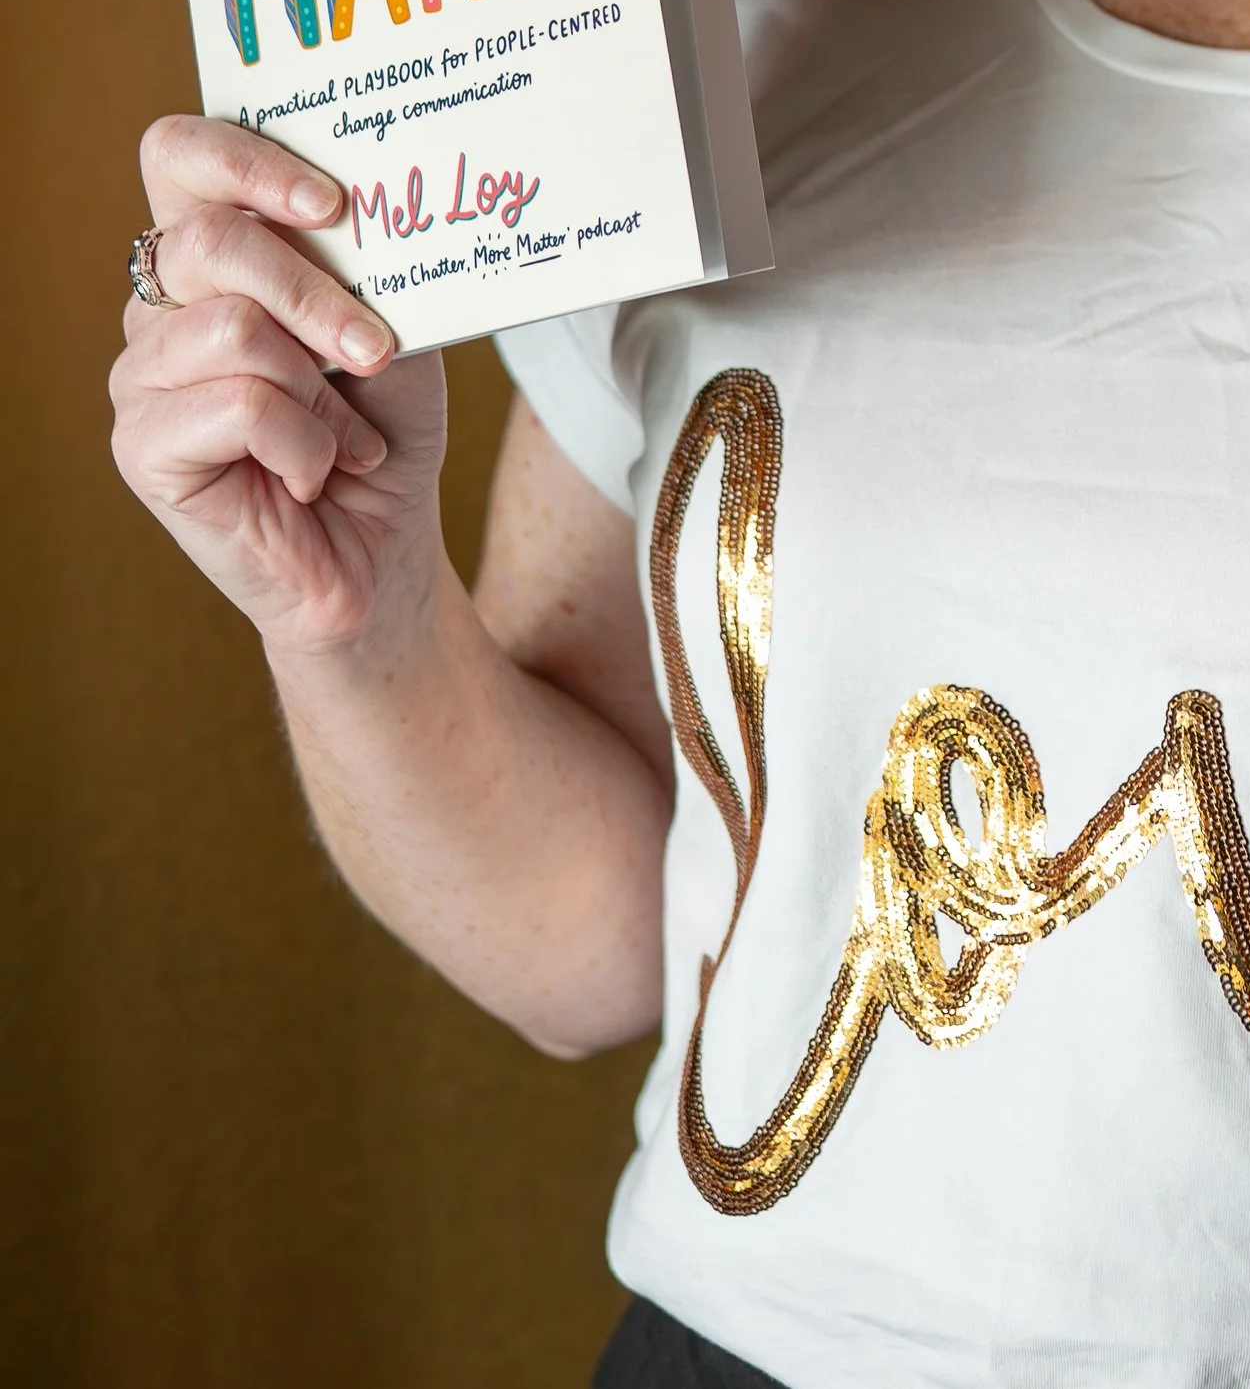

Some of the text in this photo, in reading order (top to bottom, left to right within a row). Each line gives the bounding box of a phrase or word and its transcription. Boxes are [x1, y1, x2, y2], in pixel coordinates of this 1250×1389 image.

[237, 3, 621, 134] A practical PLAYBOOK for PEOPLE-CENTRED
[332, 71, 532, 142] change communication
[351, 151, 541, 249] Mel Loy
[368, 273, 407, 296] 'Less
[410, 257, 471, 287] Chatter,
[473, 244, 512, 269] More
[516, 226, 571, 257] Matter'
[577, 210, 642, 248] podcast
